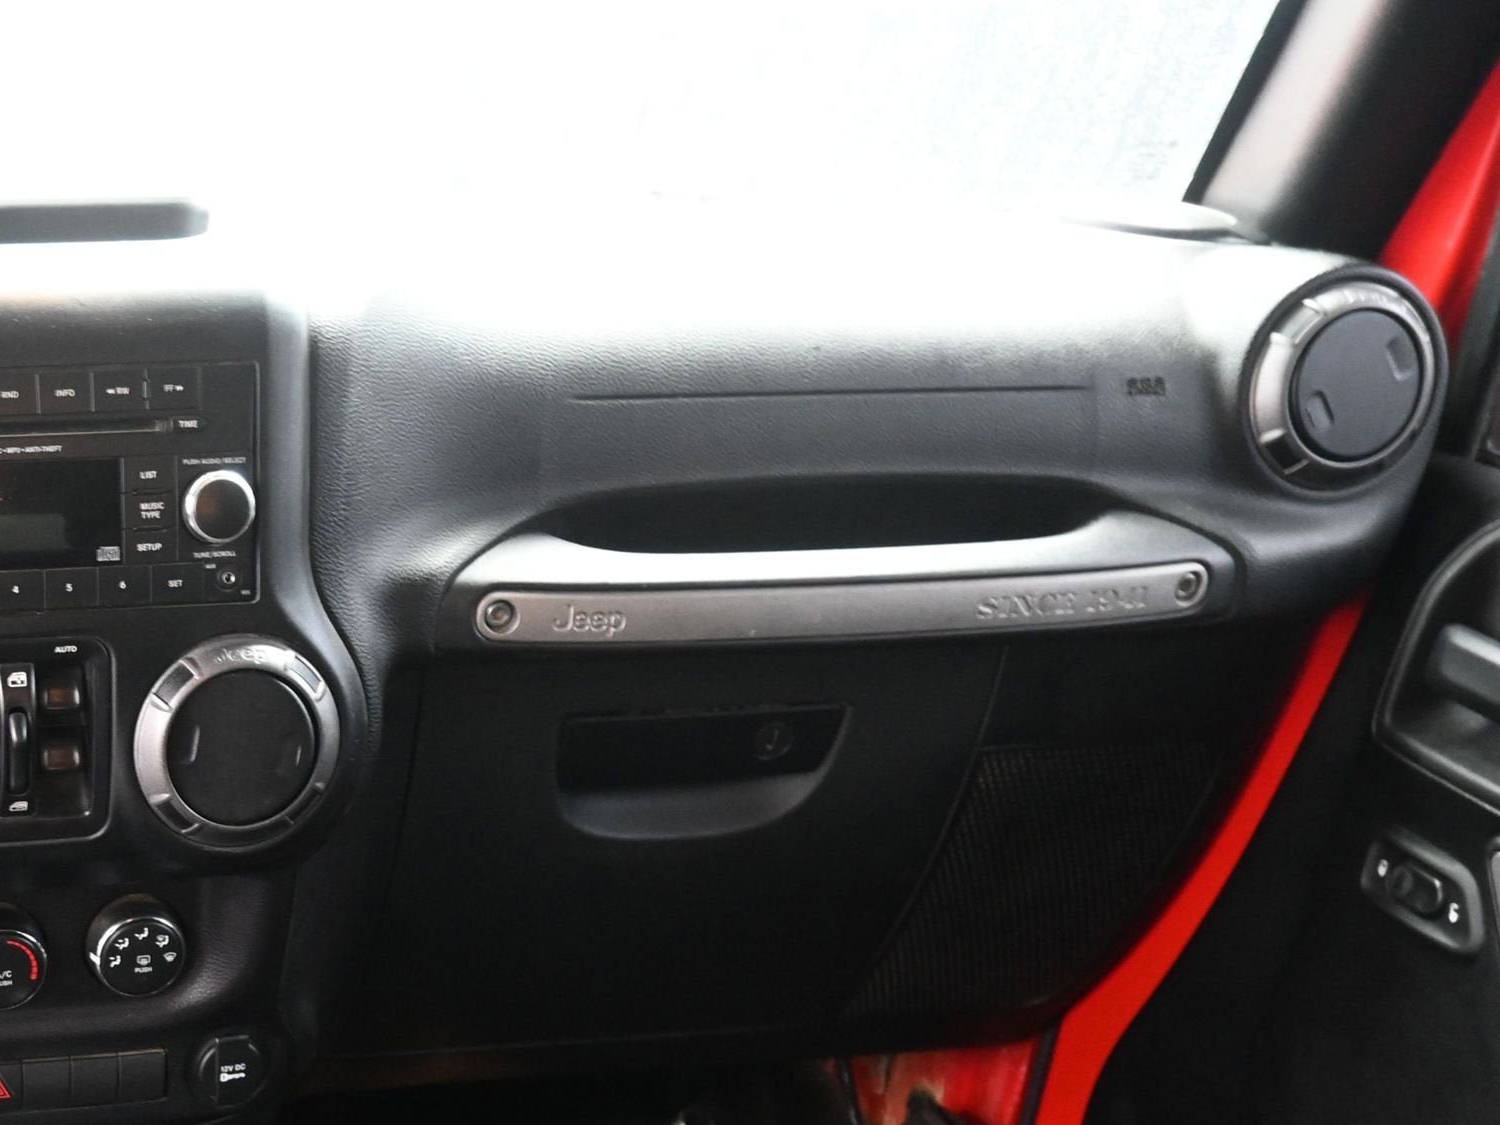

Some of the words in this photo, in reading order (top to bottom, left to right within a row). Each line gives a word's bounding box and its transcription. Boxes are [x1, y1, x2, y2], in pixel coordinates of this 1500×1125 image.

[54, 388, 76, 397] INFO
[115, 387, 130, 395] RW
[163, 384, 175, 393] FF
[0, 390, 19, 399] RND
[178, 420, 199, 428] TIME
[139, 470, 158, 479] LIST
[139, 502, 165, 510] MUSIC
[140, 511, 161, 519] TYPE
[136, 543, 163, 552] SETUP
[65, 583, 73, 592] 5
[118, 580, 127, 589] 6
[167, 579, 183, 588] SET
[11, 585, 20, 594] 4
[552, 603, 627, 637] Jeep
[54, 645, 77, 653] AUTO
[134, 966, 153, 974] PUSH
[220, 1064, 233, 1073] 12V
[234, 1063, 246, 1071] DC
